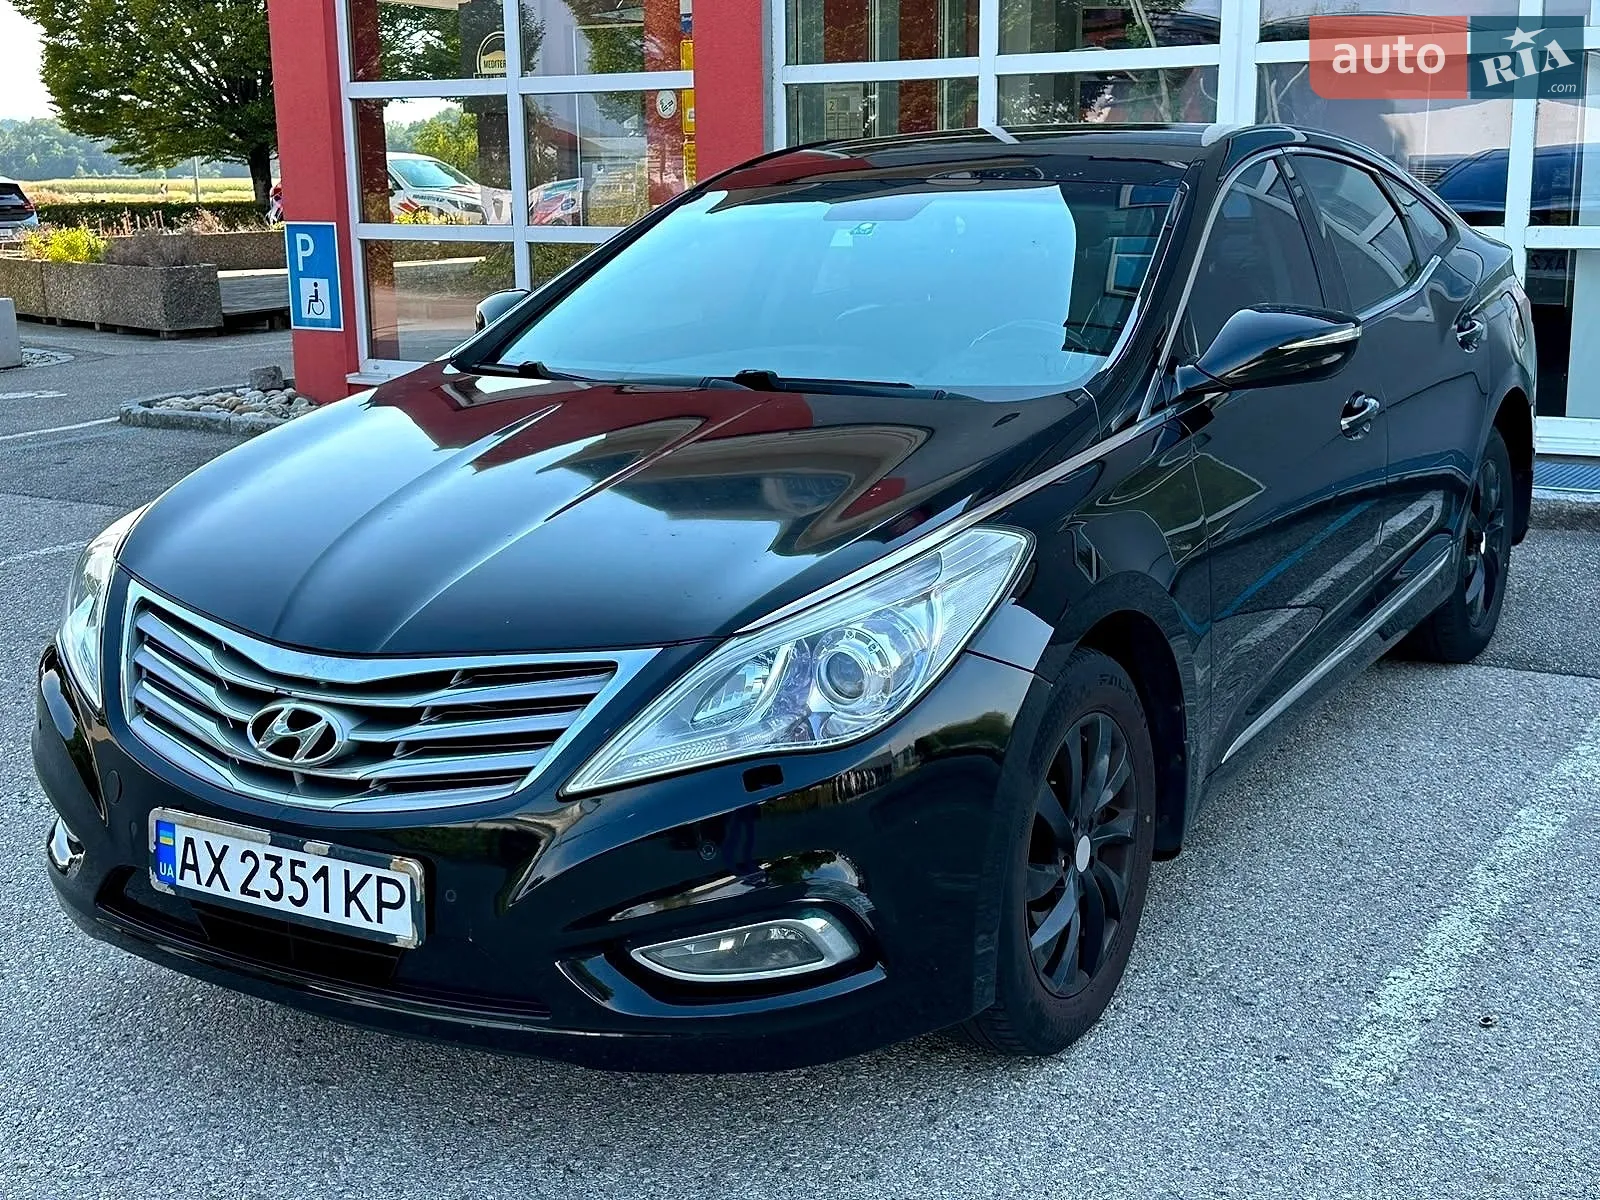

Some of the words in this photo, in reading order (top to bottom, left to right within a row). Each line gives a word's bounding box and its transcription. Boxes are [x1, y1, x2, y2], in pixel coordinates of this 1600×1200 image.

[295, 233, 314, 272] P
[159, 861, 175, 878] UA
[179, 836, 230, 892] AX
[240, 849, 330, 913] 2351
[344, 869, 406, 924] KP
